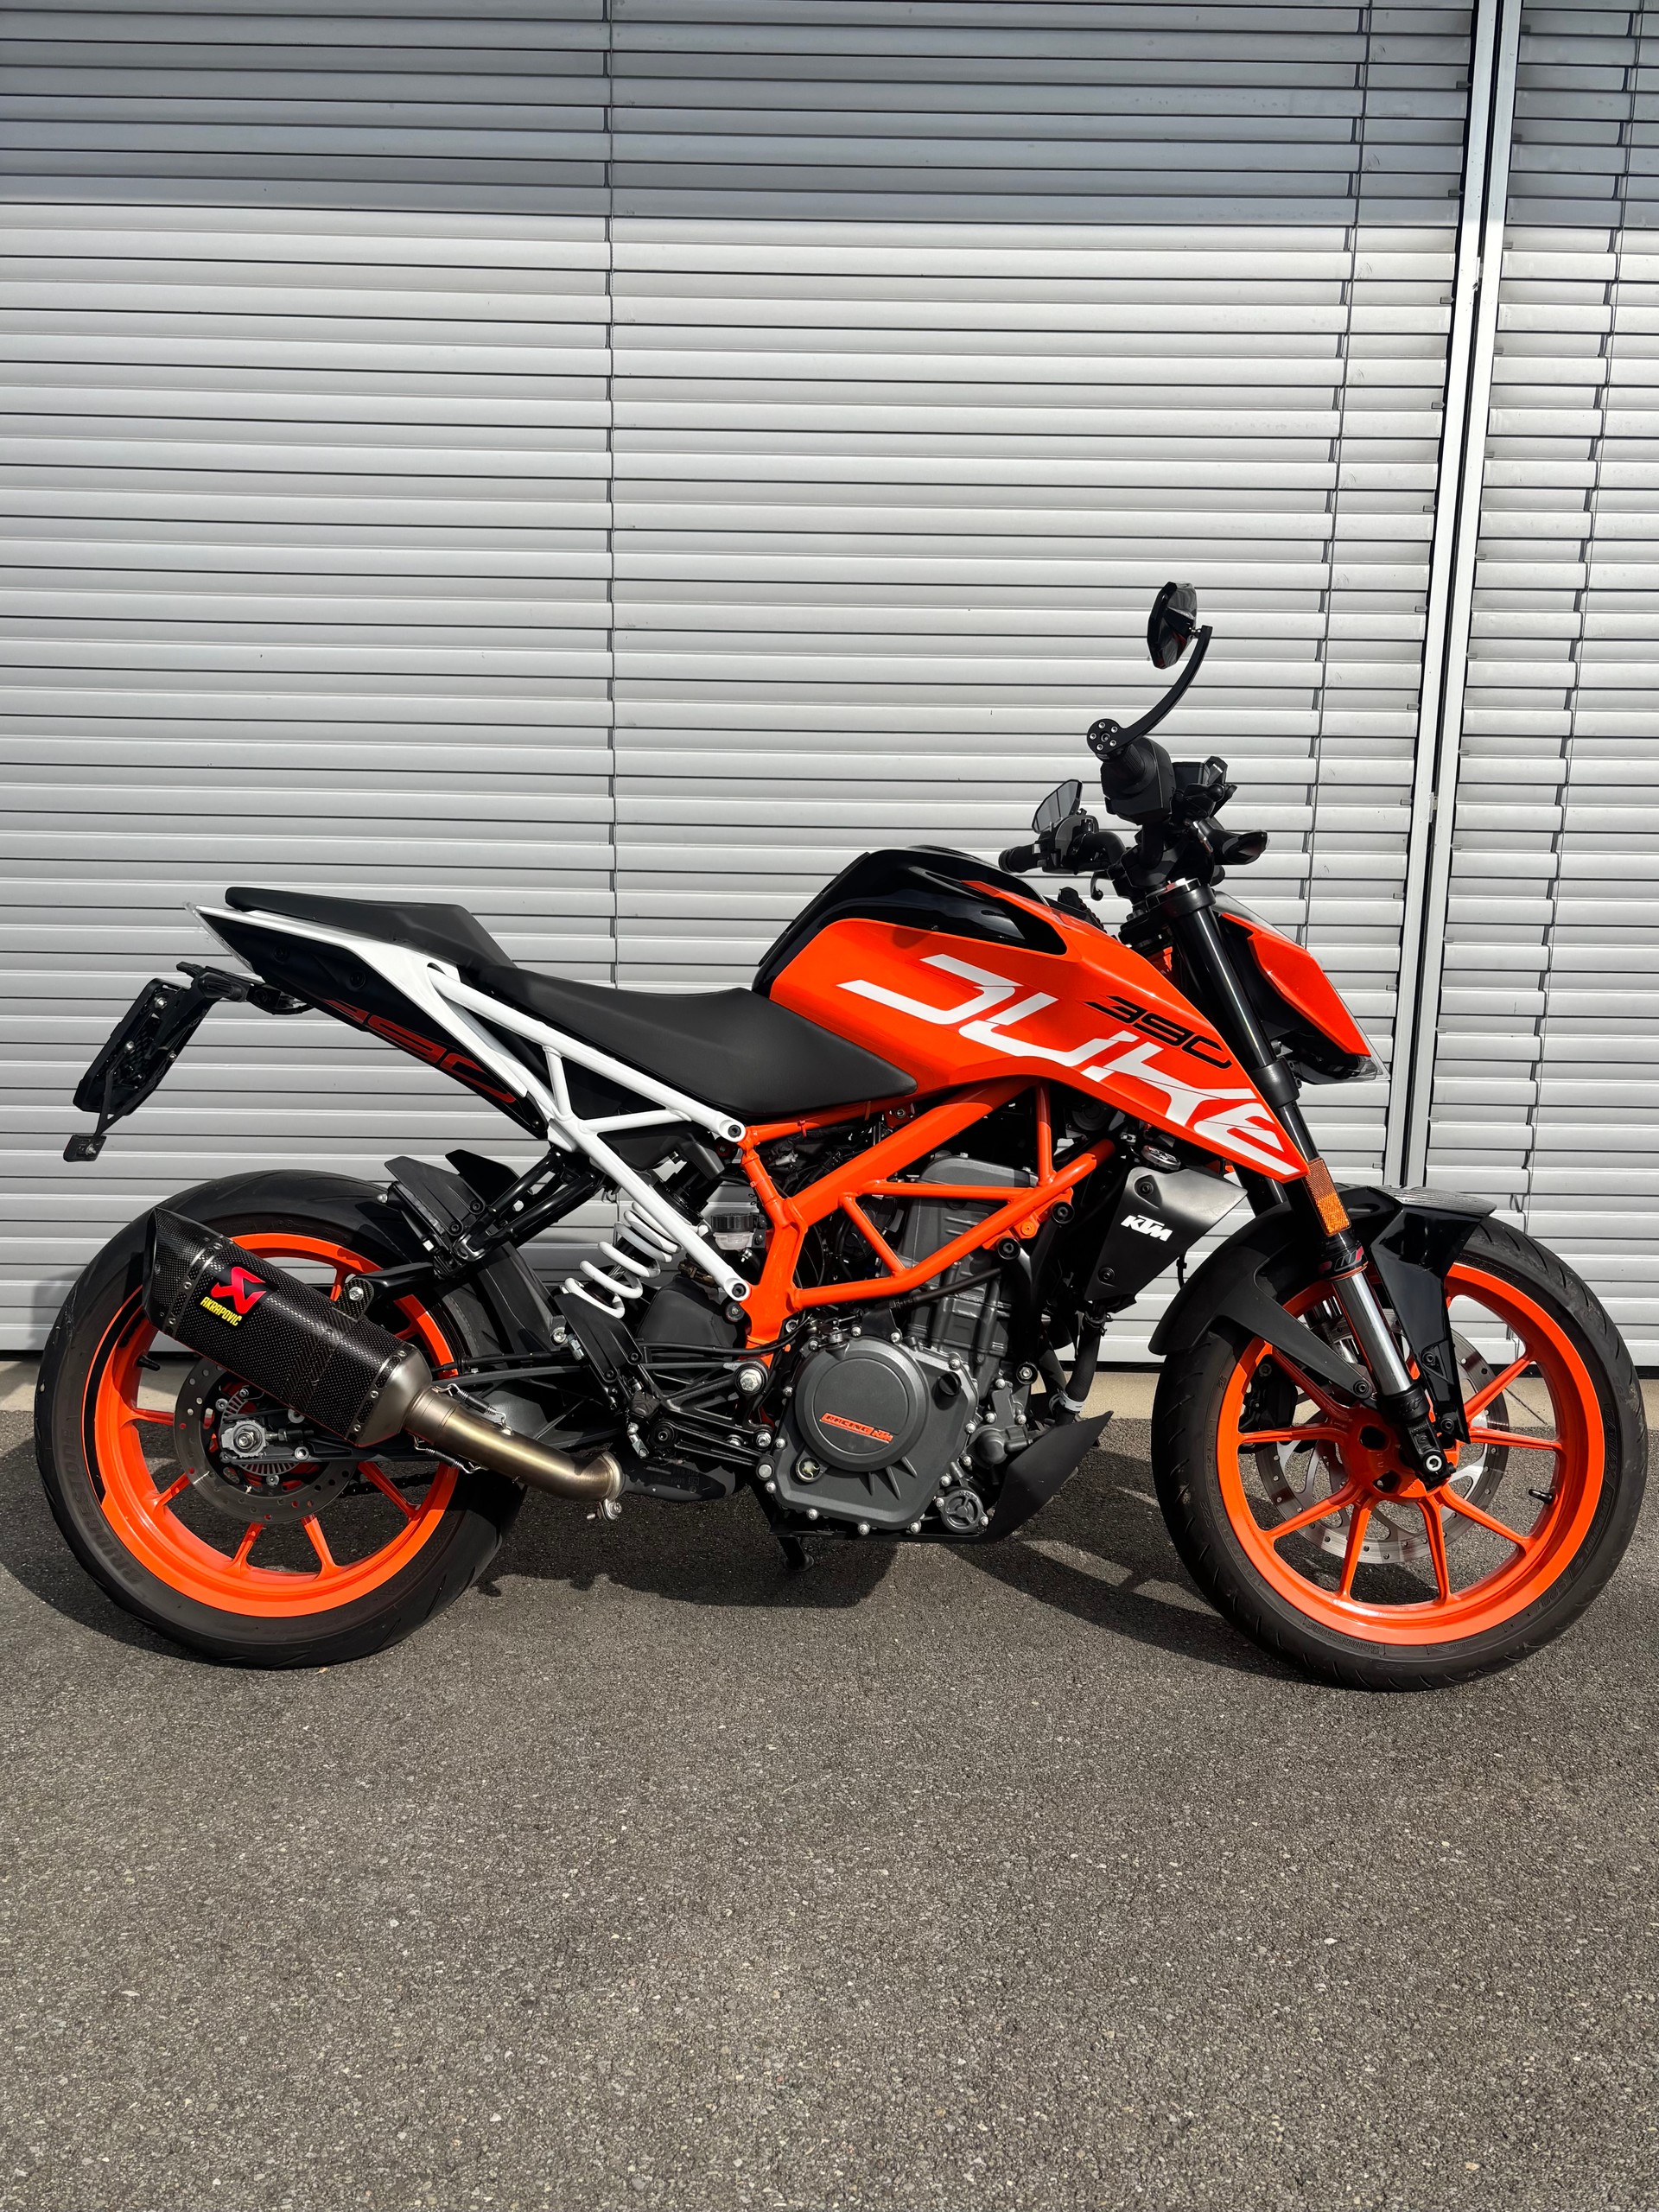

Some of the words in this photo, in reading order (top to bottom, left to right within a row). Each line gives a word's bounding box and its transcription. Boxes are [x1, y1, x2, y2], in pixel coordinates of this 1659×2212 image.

[323, 999, 517, 1103] 390
[836, 953, 1300, 1175] DUKE
[1084, 995, 1231, 1070] 390
[1120, 1214, 1173, 1242] KTM
[62, 1428, 146, 1585] BRIDGESTONE
